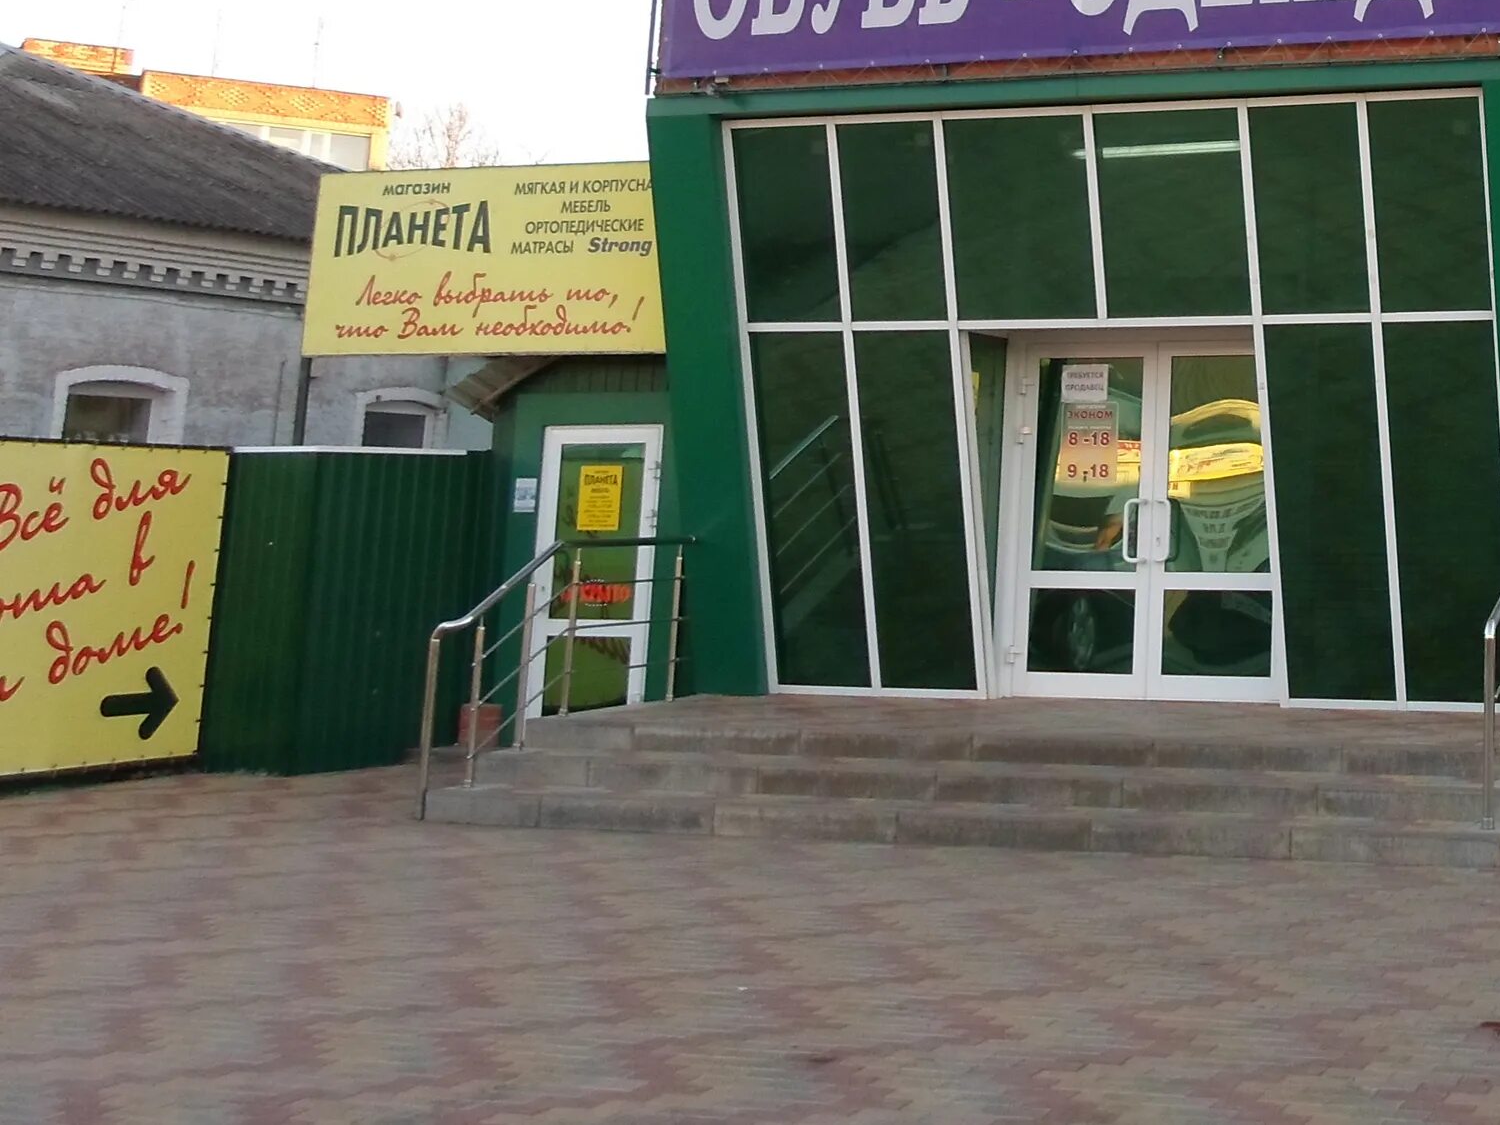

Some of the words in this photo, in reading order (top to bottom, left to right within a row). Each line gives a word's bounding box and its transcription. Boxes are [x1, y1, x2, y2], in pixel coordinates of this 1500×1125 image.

[382, 181, 451, 197] магазин
[514, 181, 566, 195] МЯГКАЯ
[569, 181, 579, 194] И
[560, 200, 611, 214] МЕБЕЛЬ
[333, 200, 492, 258] ПЛАНЕТА
[525, 218, 645, 235] ОРТОПЕДИЧЕСКИЕ
[511, 240, 574, 255] МАТРАСЫ
[588, 236, 653, 257] Strong
[355, 274, 423, 306] Легко
[433, 271, 554, 318] выбрать
[335, 323, 388, 338] что
[397, 307, 464, 339] Вам
[1067, 410, 1113, 418] ЭКОНОМ
[90, 458, 192, 520] для
